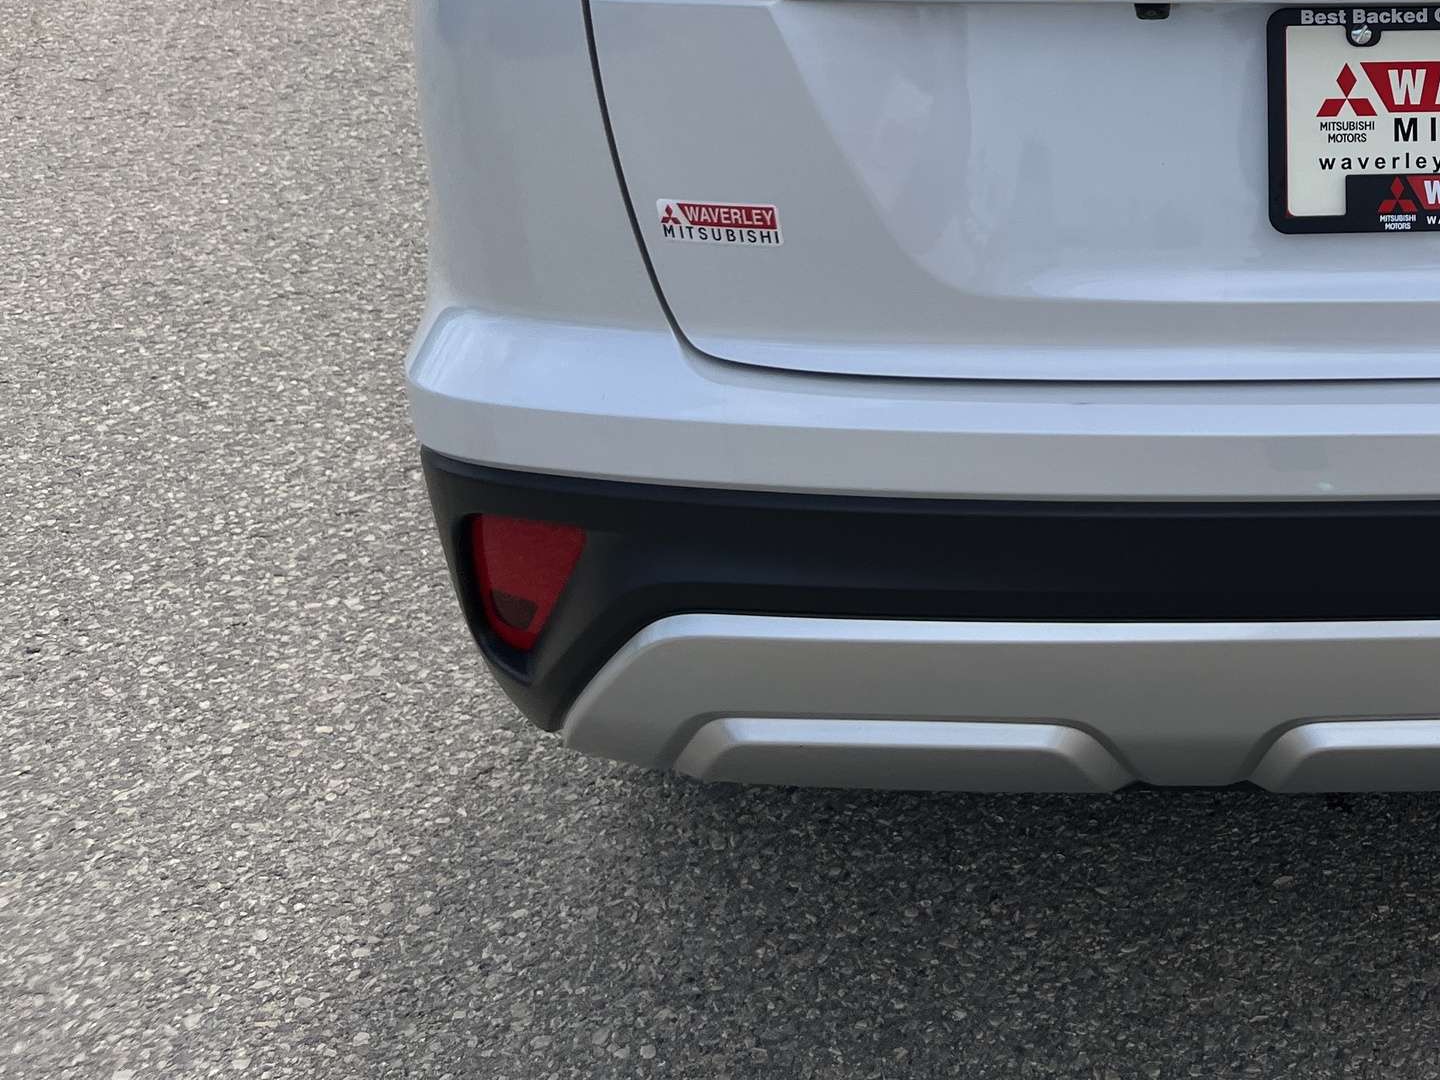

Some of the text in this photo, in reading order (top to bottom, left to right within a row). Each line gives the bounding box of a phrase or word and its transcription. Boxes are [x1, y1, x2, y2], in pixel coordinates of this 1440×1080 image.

[1300, 9, 1347, 25] Best
[1352, 8, 1428, 24] Backed
[1320, 120, 1375, 132] MITSUBISHI
[1328, 132, 1367, 143] MOTORS
[684, 206, 773, 225] WAVERLEY
[1379, 214, 1417, 222] MITSUBISHI
[1384, 222, 1411, 230] MOTORS
[663, 224, 779, 244] MITSUBISHI
